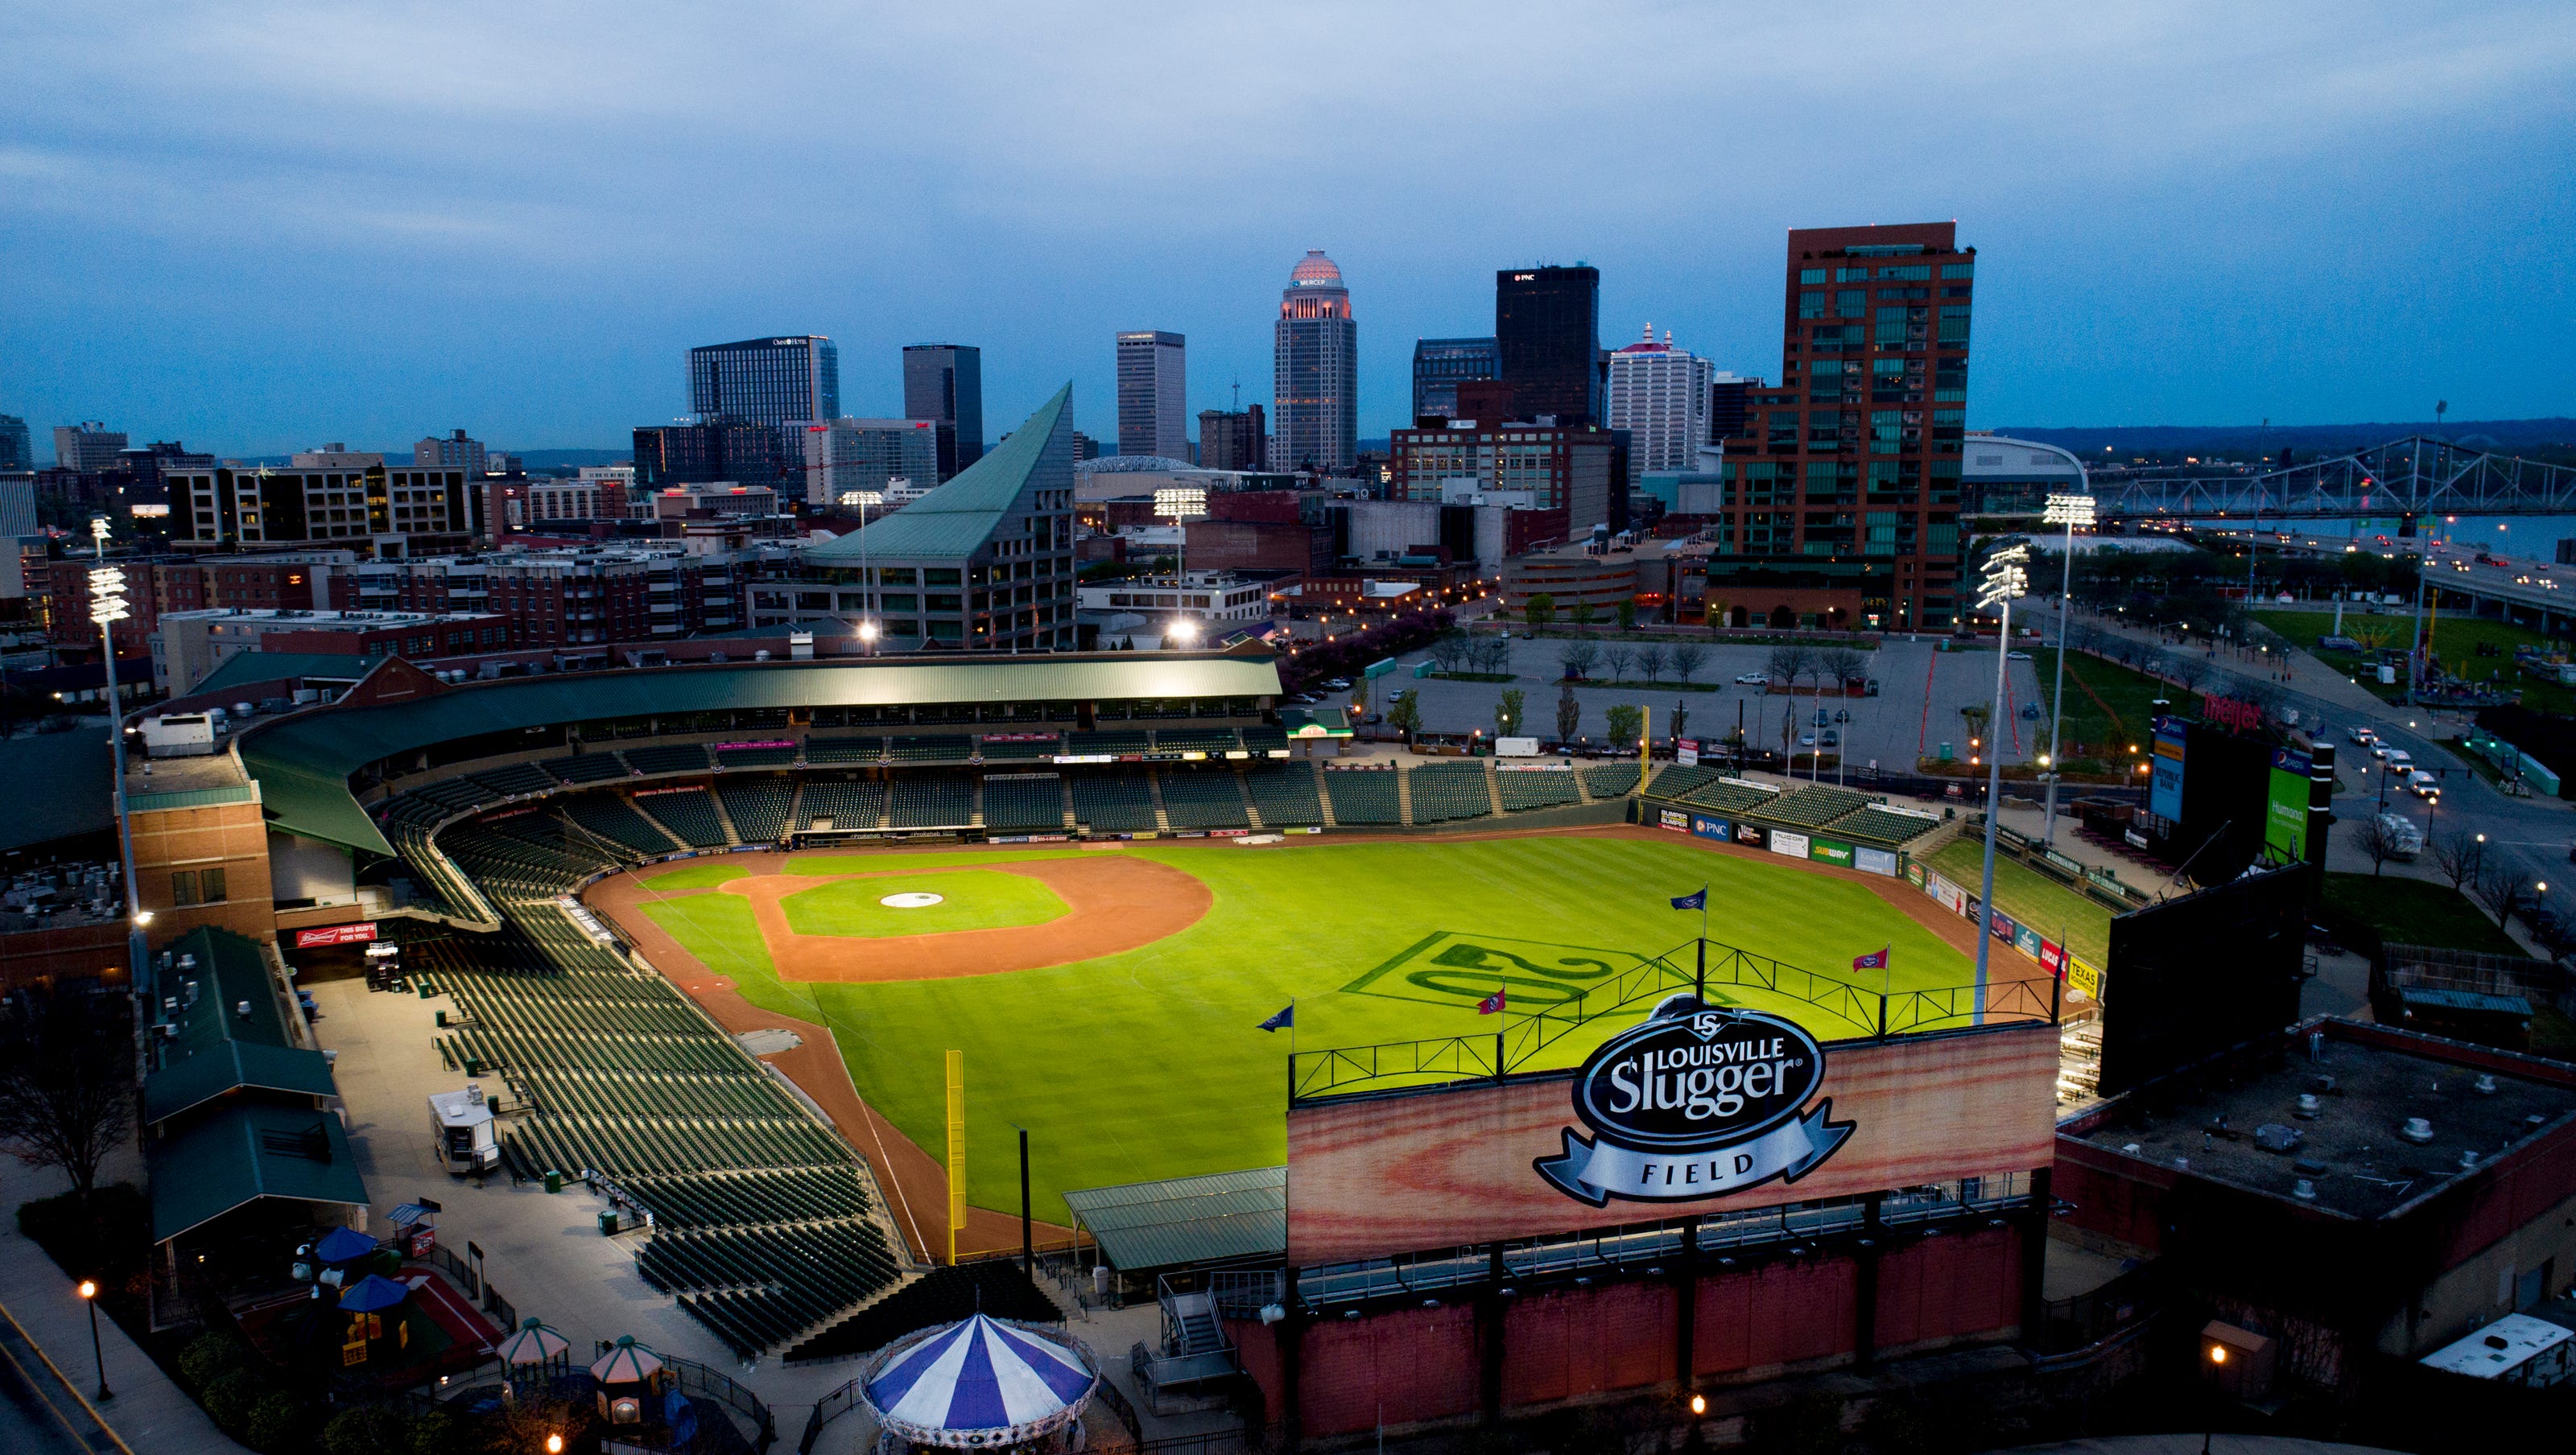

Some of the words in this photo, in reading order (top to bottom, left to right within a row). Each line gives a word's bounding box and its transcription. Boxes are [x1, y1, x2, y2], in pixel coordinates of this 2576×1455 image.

[2203, 693, 2261, 735] meijer
[1661, 809, 1687, 820] BUMPER
[2272, 799, 2303, 822] Humana
[1661, 818, 1687, 828] BUMPER
[1707, 822, 1726, 836] PNC
[1775, 832, 1804, 843] NUCOR
[1814, 846, 1847, 859] SUBWAY
[339, 925, 354, 934] THIS
[355, 924, 375, 932] BUD'S
[303, 934, 335, 942] Budweiser
[2041, 947, 2059, 967] LUCAS
[2072, 962, 2095, 986] TEXAS
[1657, 1037, 1785, 1070] LOUISVILLE
[1609, 1051, 1794, 1120] Slugger
[1641, 1153, 1754, 1186] FIELD
